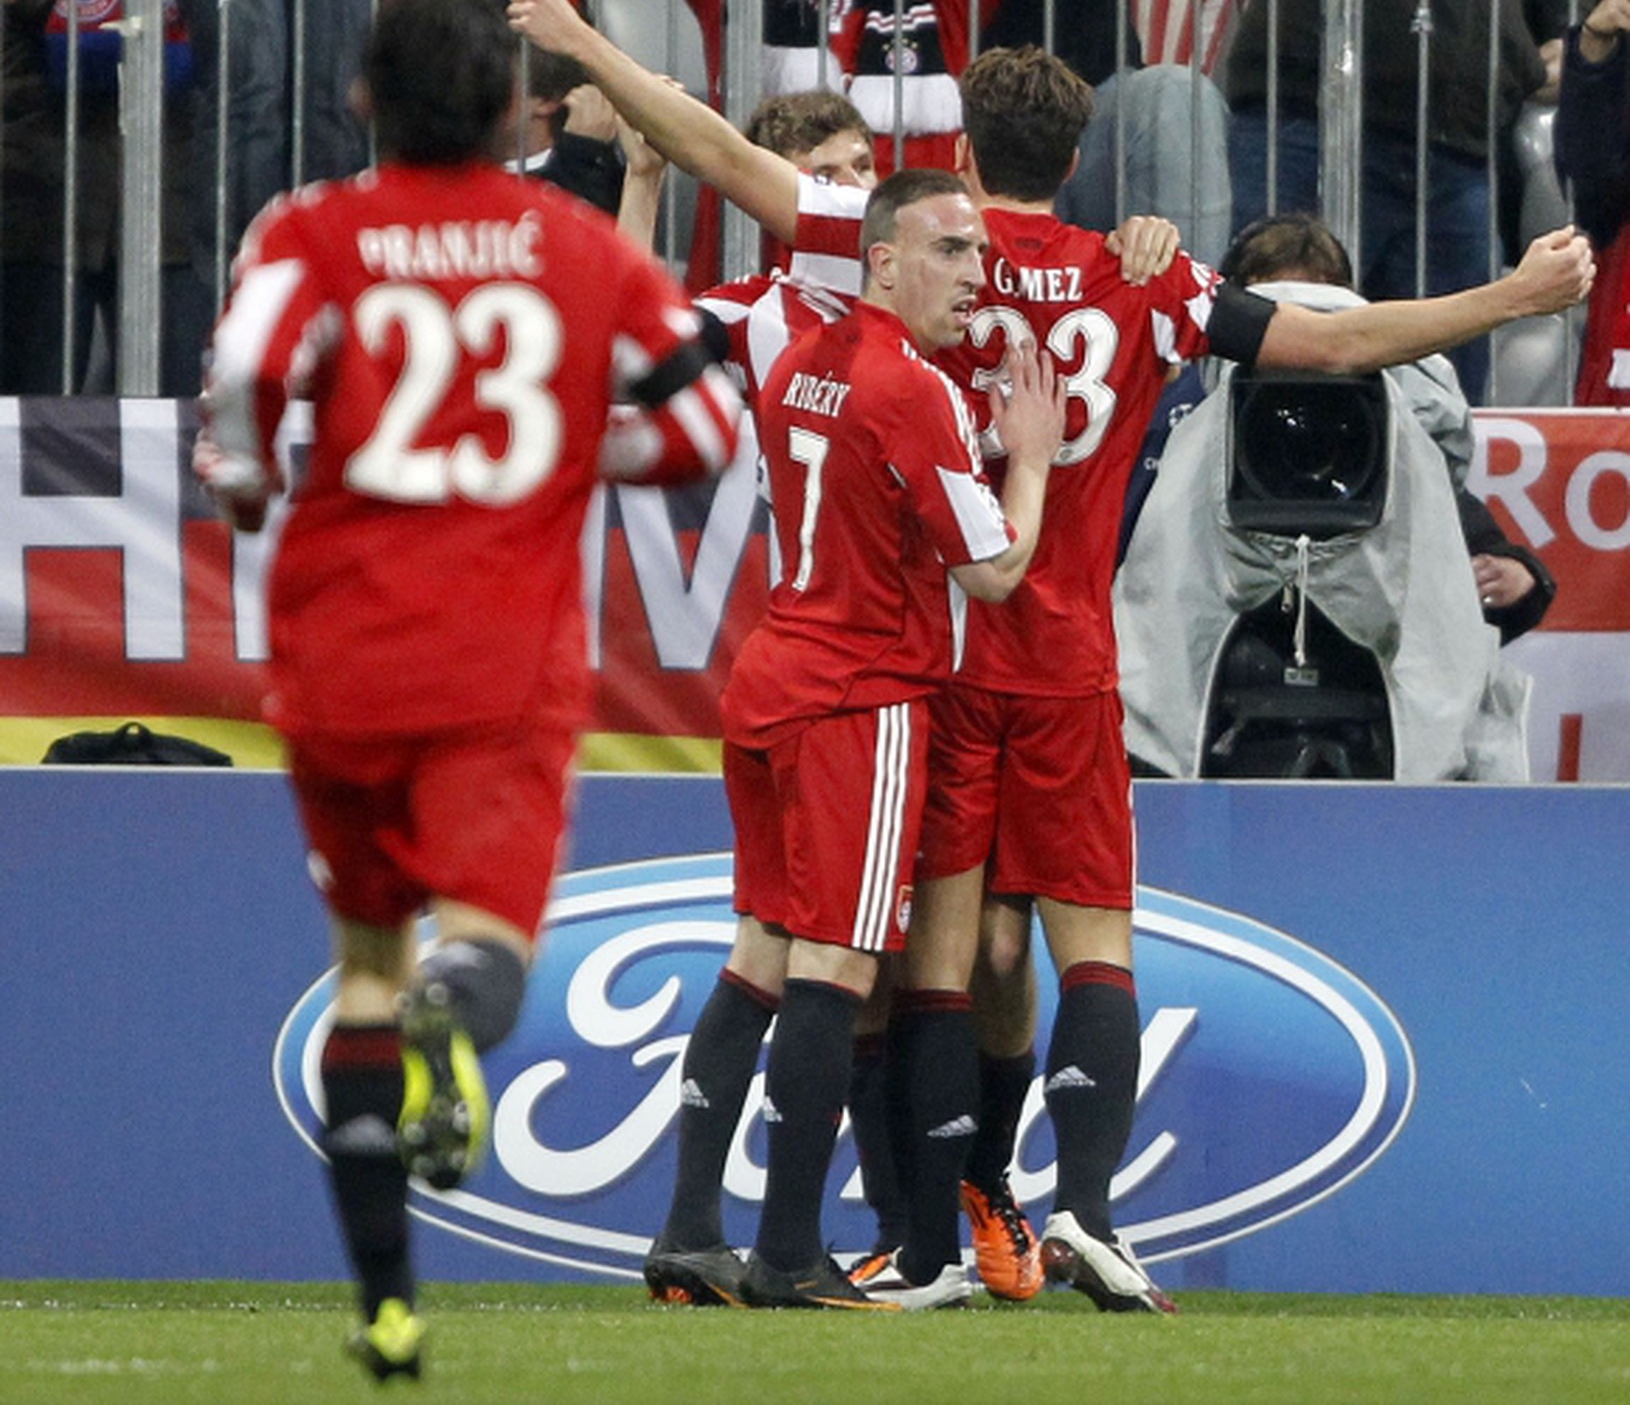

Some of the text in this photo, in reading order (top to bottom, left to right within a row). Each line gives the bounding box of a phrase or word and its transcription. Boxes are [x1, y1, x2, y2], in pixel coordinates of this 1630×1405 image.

[356, 209, 545, 280] PRANJIĆ
[993, 257, 1084, 302] GMEZ
[343, 280, 565, 507] 23
[782, 370, 851, 418] RIBÉRY
[788, 425, 830, 592] 7
[494, 921, 1198, 1202] Fd
